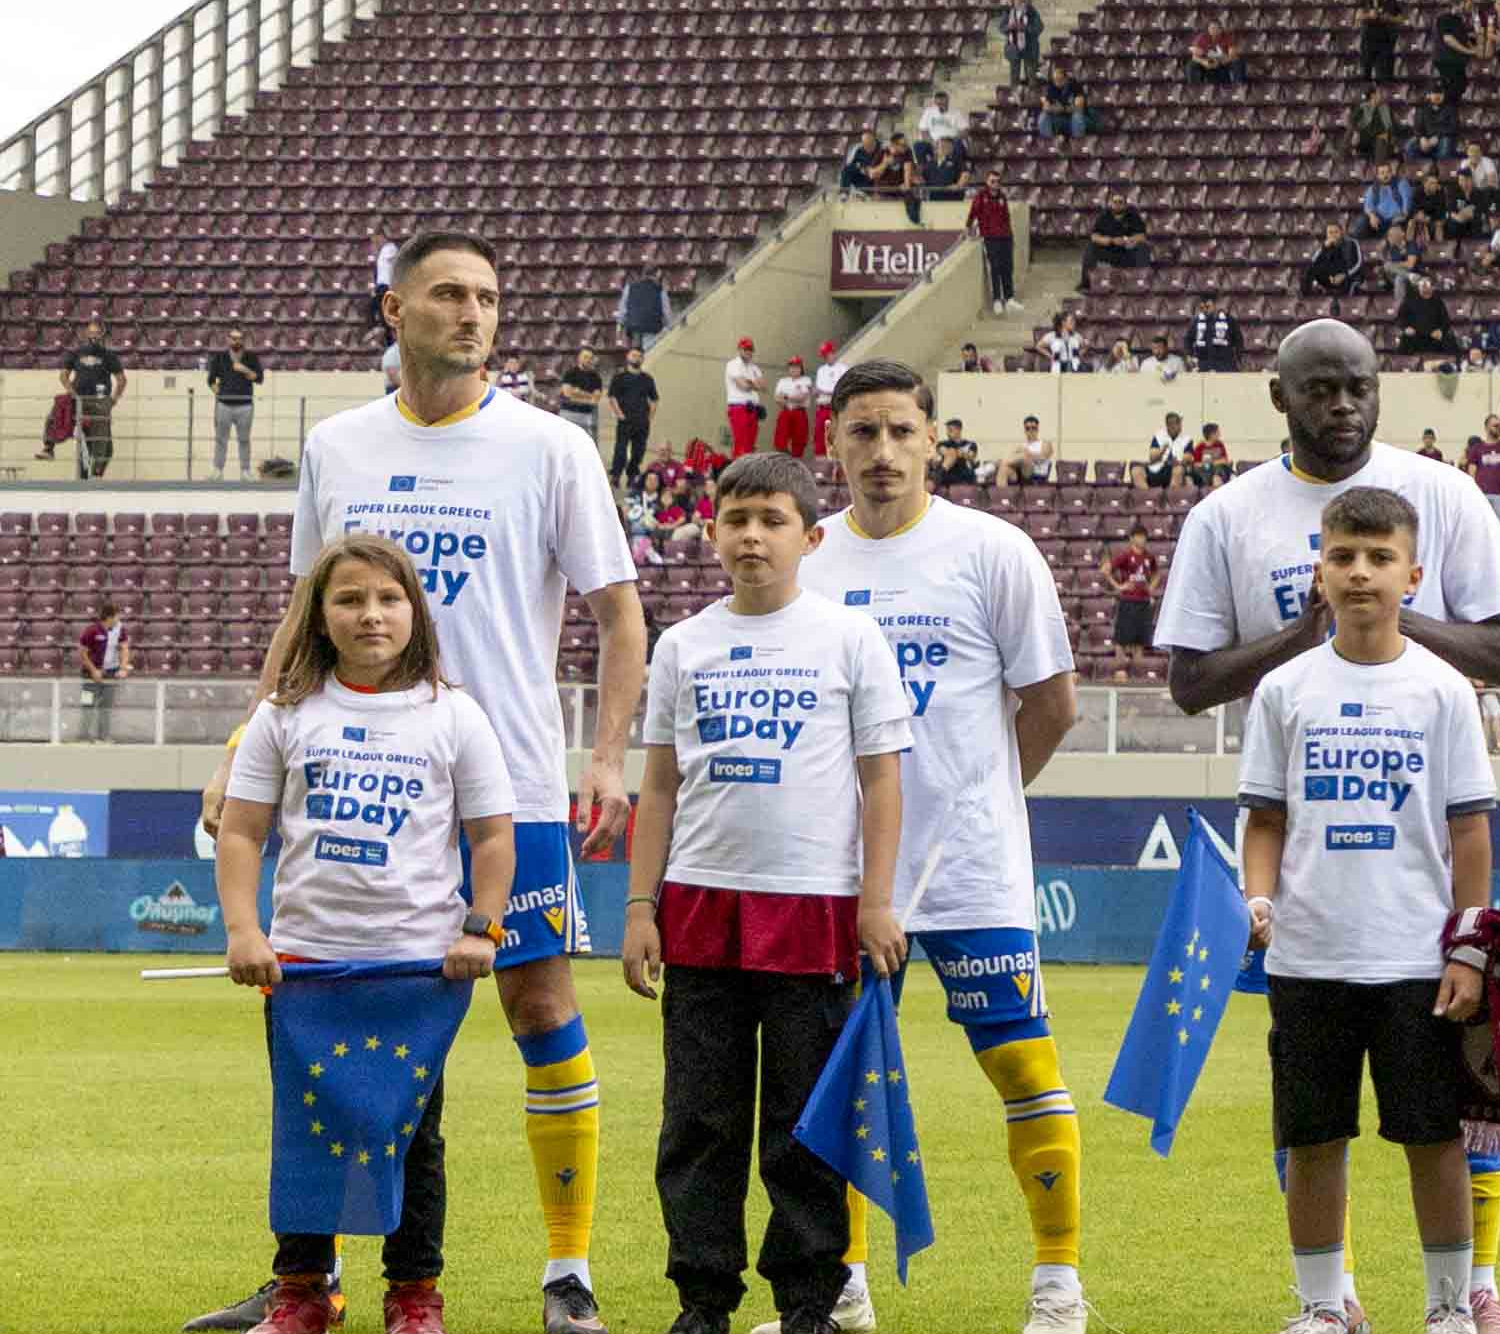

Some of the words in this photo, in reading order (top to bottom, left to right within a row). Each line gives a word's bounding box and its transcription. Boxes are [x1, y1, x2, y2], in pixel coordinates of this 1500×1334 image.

[347, 503, 384, 515] SUPER
[387, 504, 436, 516] LEAGUE
[439, 505, 492, 521] GREECE
[1270, 564, 1313, 581] SUPER
[897, 615, 951, 627] GREECE
[730, 667, 773, 679] LEAGUE
[776, 667, 819, 678] GREECE
[694, 684, 818, 717] Europe
[729, 714, 805, 750] Day
[1340, 727, 1381, 737] LEAGUE
[306, 748, 339, 758] SUPER
[341, 749, 384, 763] LEAGUE
[1304, 741, 1425, 780] Europe
[304, 760, 424, 803] Europe
[1342, 775, 1414, 812] Day
[335, 795, 411, 837] Day
